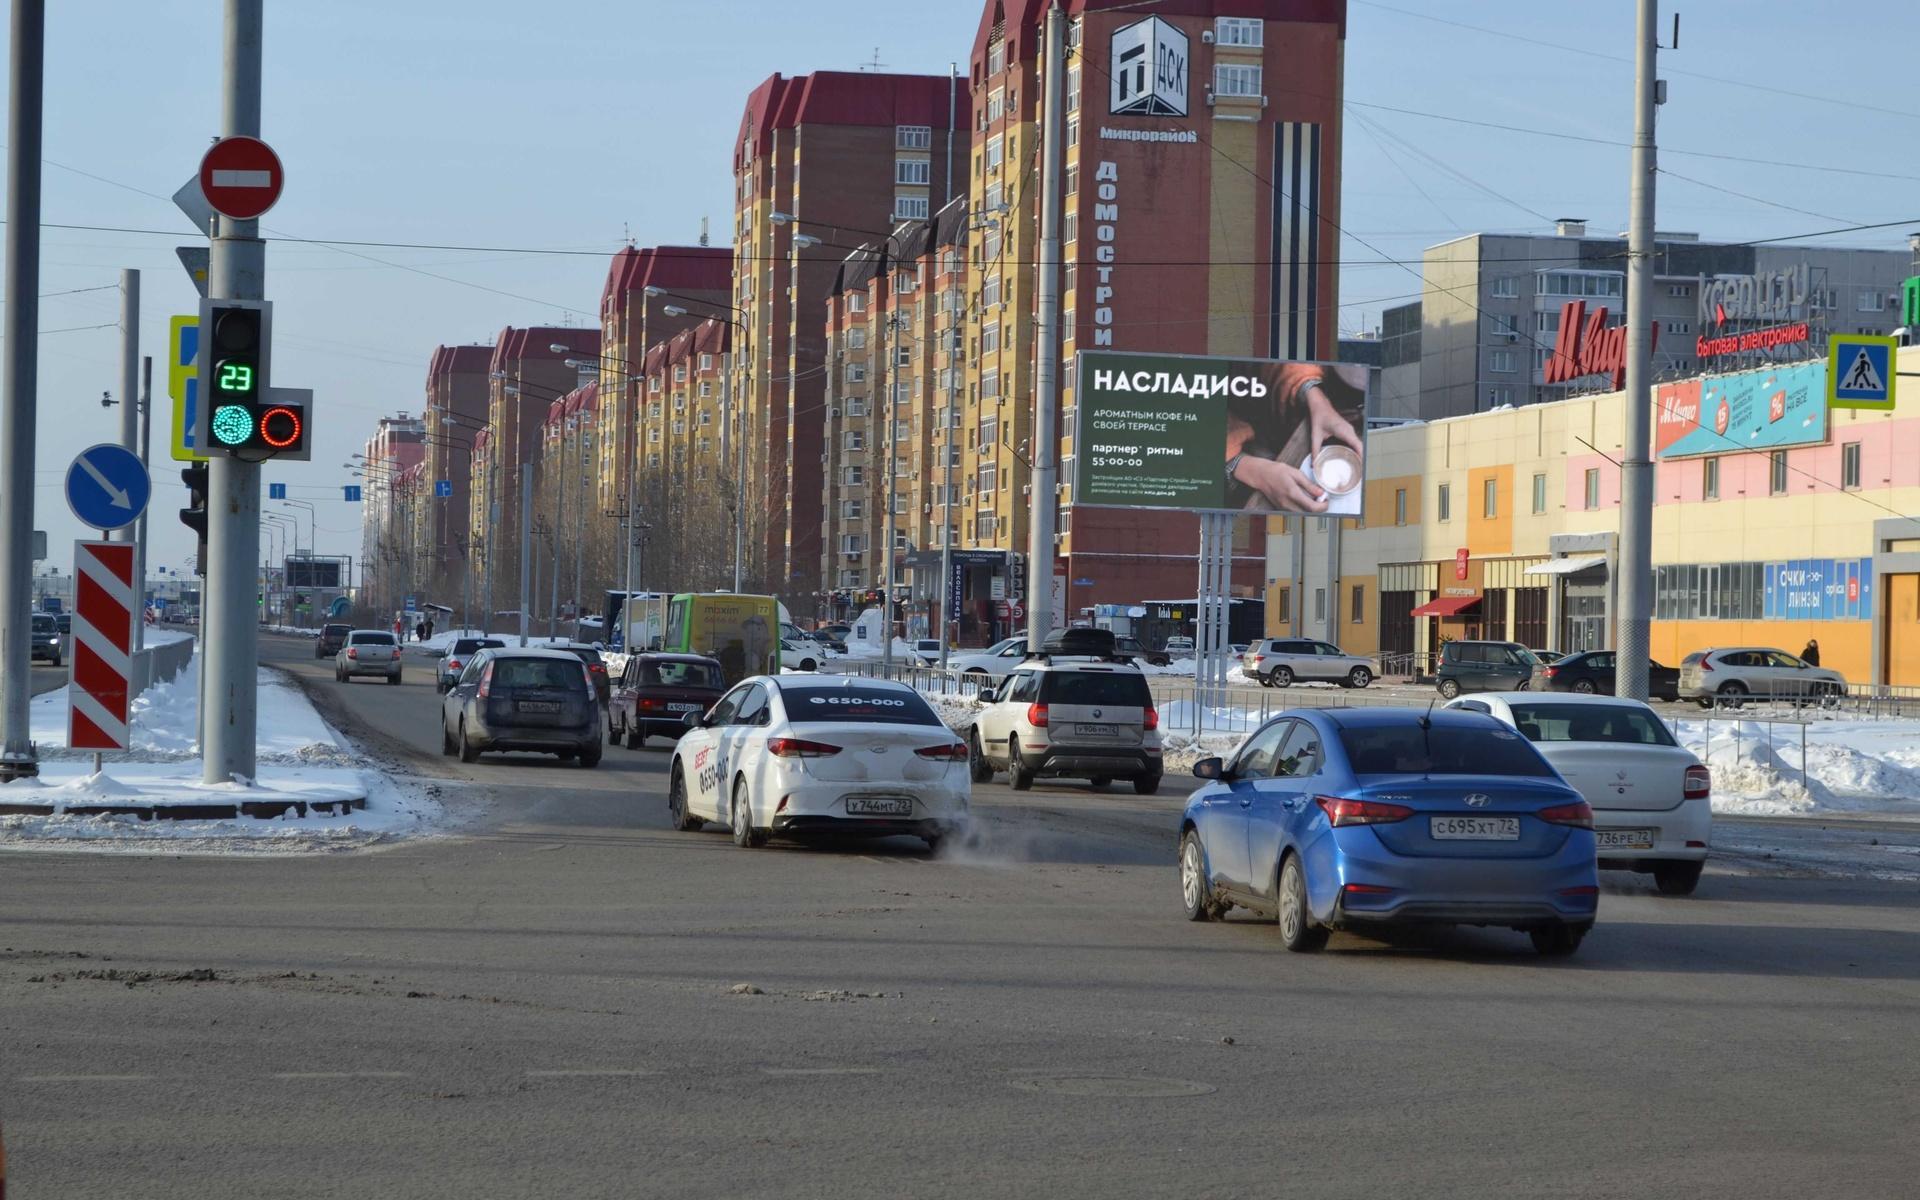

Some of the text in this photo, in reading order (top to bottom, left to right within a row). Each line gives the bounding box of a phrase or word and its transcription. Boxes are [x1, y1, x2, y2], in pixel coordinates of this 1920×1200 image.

[1158, 41, 1184, 97] ДСК
[1100, 126, 1197, 143] Микрорайон
[1543, 299, 1659, 391] М.вид
[1696, 323, 1809, 357] бытовая электроника
[221, 365, 251, 391] 23
[1094, 369, 1267, 399] НАСЛАДИСЬ
[1093, 409, 1198, 421] АРОМАТНЫМ КОФЕ НА
[1093, 420, 1167, 432] СВОЕЙ ТЕРРАСЕ
[1147, 446, 1184, 457] ритмы
[1091, 457, 1143, 467] 55-00-00
[1780, 570, 1806, 587] ОЧКИ
[1788, 591, 1820, 608] ЛИНЗЫ
[704, 605, 739, 616] maxim
[759, 606, 769, 614] 77
[828, 697, 905, 706] 650-000
[896, 800, 907, 809] 72
[1501, 819, 1514, 831] 72
[1596, 831, 1649, 844] 736РЕ 72
